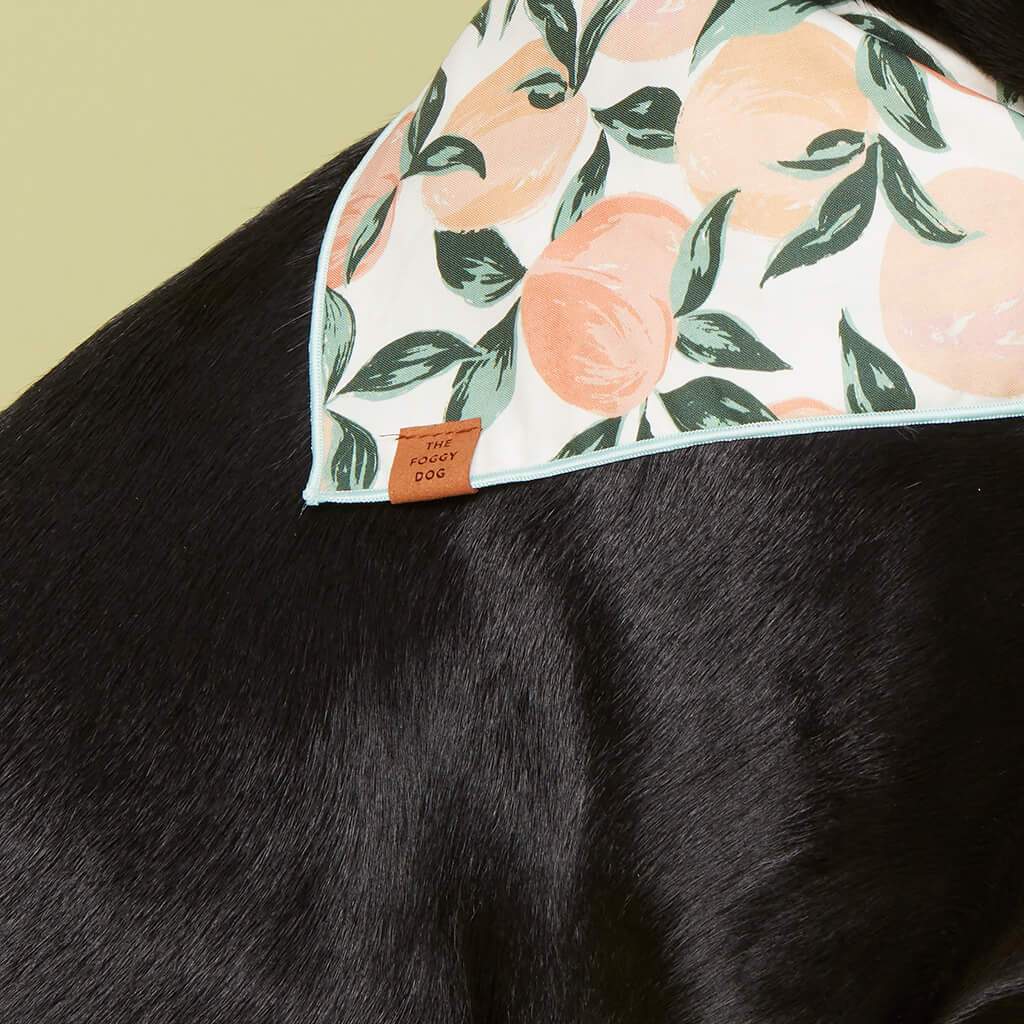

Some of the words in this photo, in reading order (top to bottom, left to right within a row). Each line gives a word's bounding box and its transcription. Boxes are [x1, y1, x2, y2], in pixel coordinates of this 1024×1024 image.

[426, 439, 453, 450] THE
[409, 451, 458, 466] FOGGY
[415, 468, 446, 482] DOG
